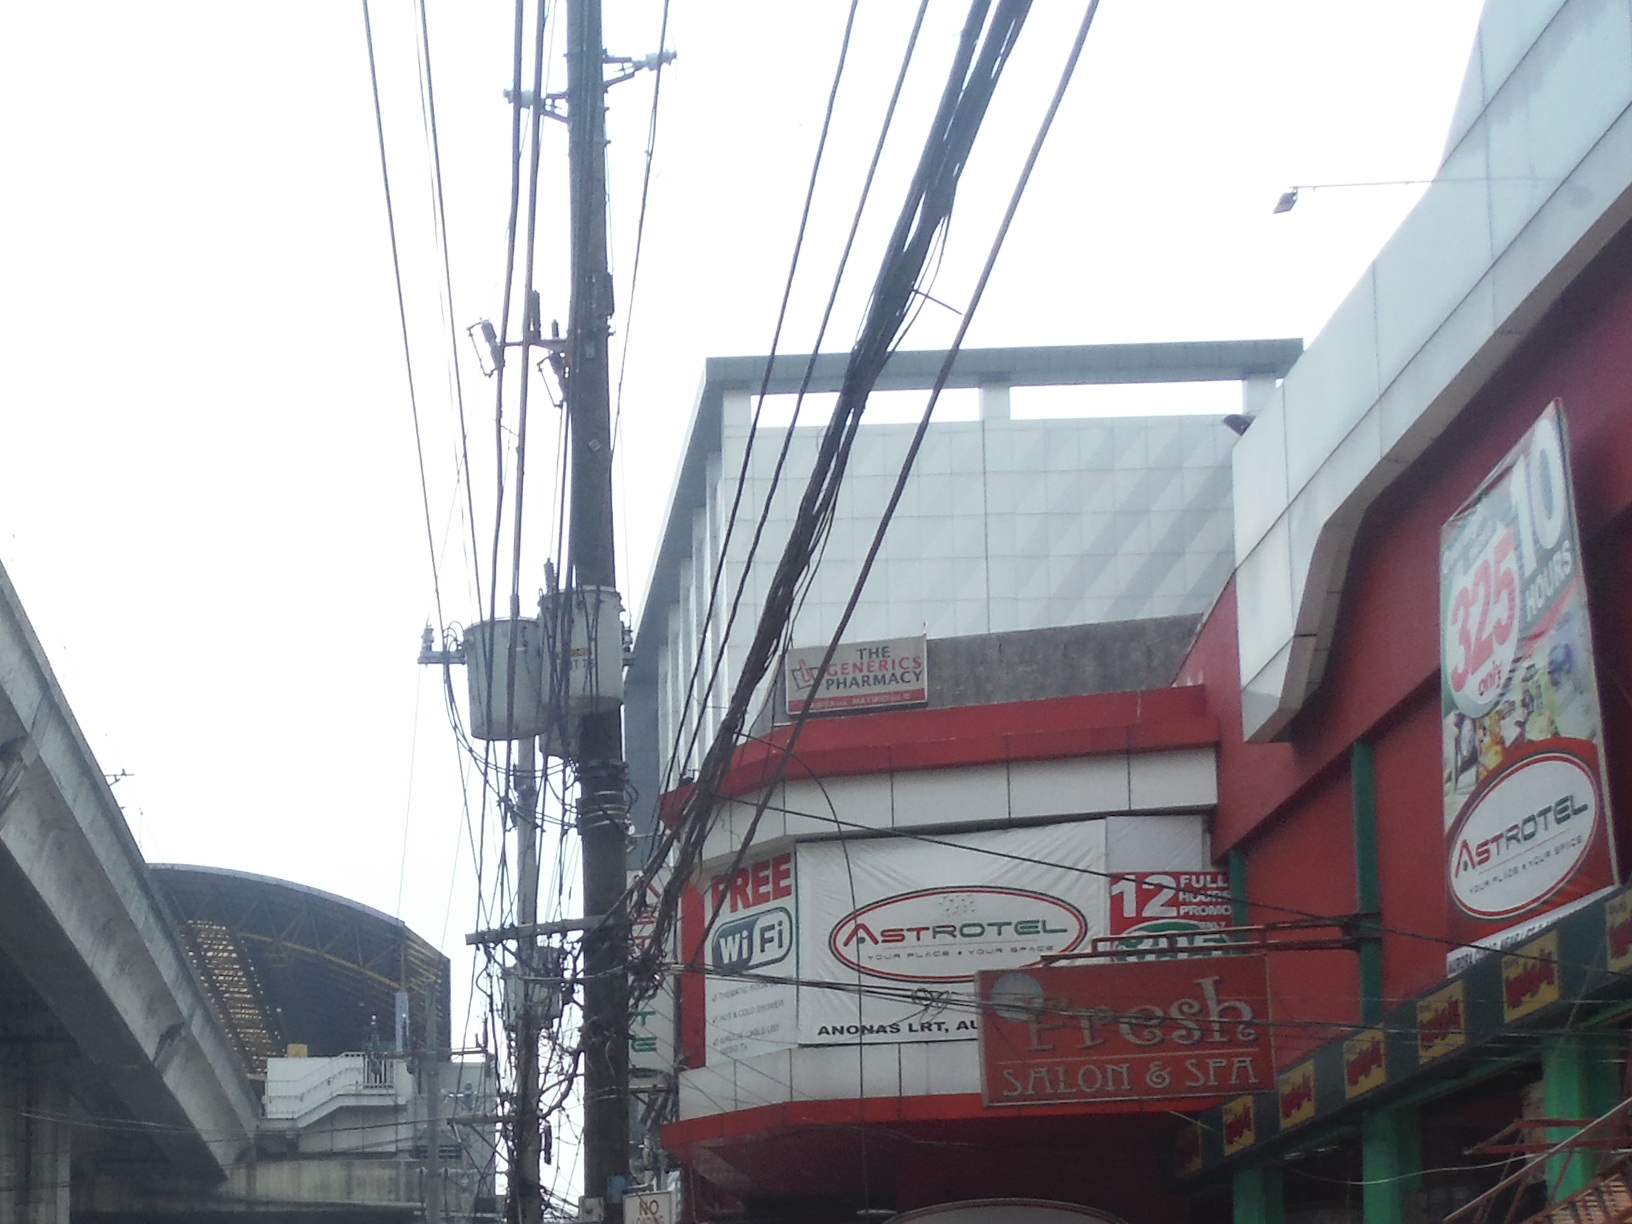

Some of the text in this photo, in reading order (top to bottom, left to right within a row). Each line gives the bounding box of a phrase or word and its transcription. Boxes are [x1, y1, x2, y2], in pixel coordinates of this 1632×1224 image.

[1510, 418, 1566, 577] 10
[1525, 539, 1572, 622] HOURS
[1451, 527, 1516, 692] 325
[827, 656, 922, 677] GENERICS
[856, 646, 892, 660] THE
[825, 670, 925, 691] PHARMACY
[1455, 794, 1588, 879] ASTROTEL
[711, 852, 792, 914] FREE
[1179, 875, 1228, 888] FULL
[1111, 874, 1177, 918] 12
[1179, 890, 1231, 902] HOURS
[1179, 904, 1232, 916] PROMO
[843, 919, 1068, 947] ASTROTEL
[1024, 976, 1257, 1051] Fresh
[818, 1022, 900, 1036] ANONAS
[908, 1021, 949, 1034] LRT,
[1003, 1057, 1258, 1097] SALON & SPA
[639, 1199, 659, 1216] NO
